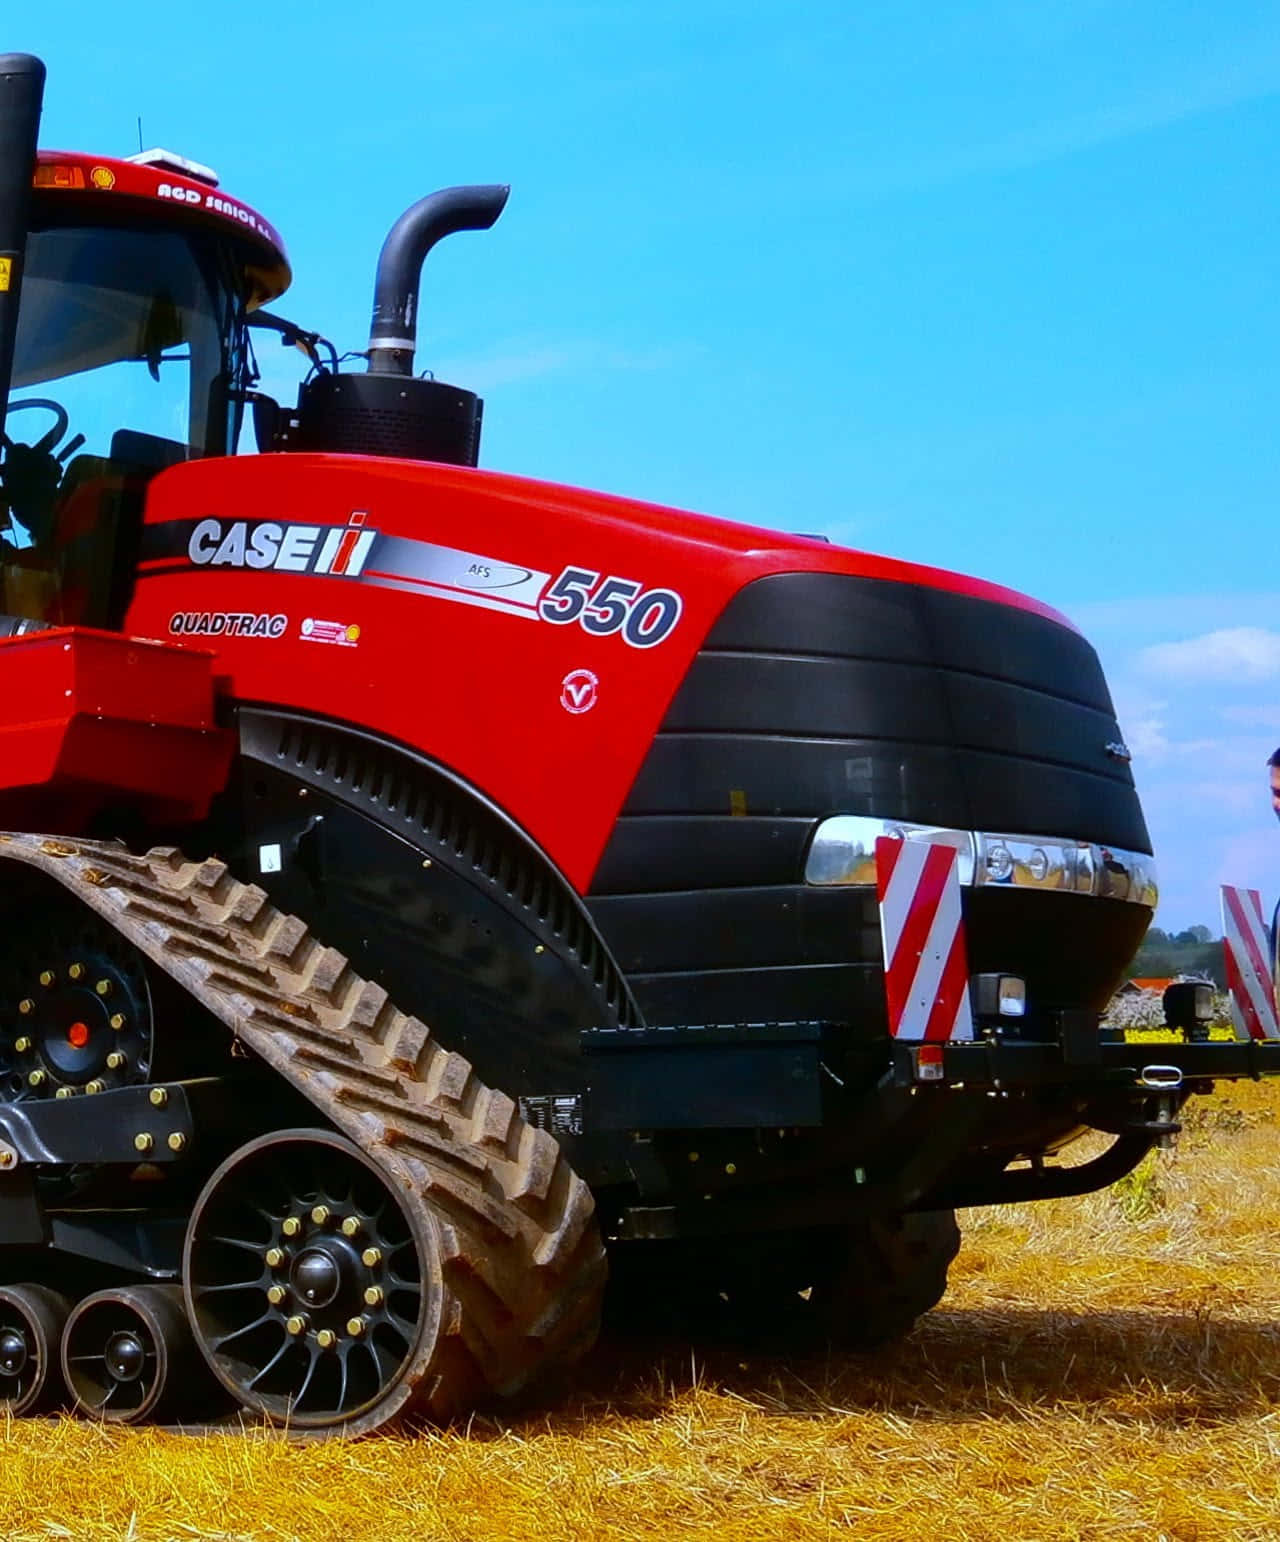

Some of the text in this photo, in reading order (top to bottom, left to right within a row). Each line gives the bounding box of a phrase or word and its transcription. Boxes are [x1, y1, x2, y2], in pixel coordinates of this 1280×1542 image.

[157, 184, 201, 204] AGD
[188, 519, 321, 571] CASE
[468, 563, 491, 578] AFS
[538, 565, 683, 649] 550
[168, 611, 288, 638] QUADTRAC
